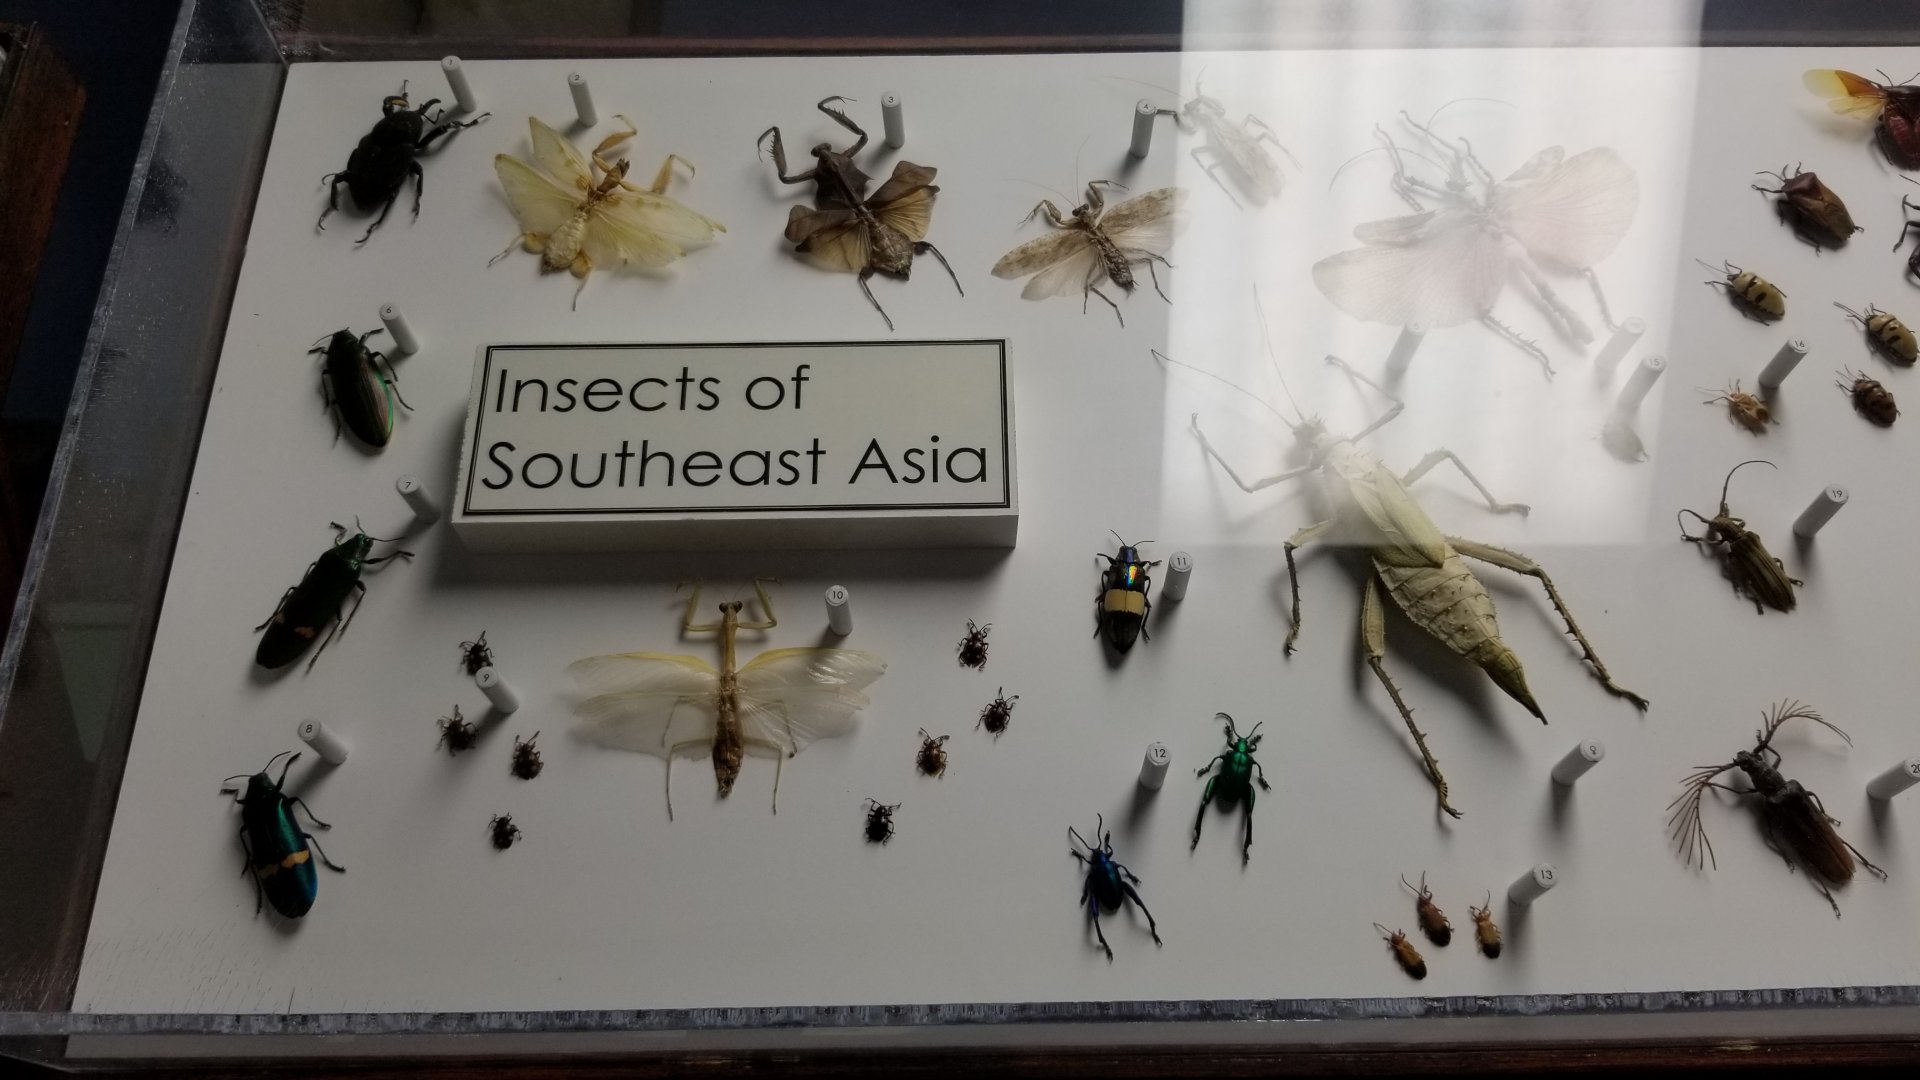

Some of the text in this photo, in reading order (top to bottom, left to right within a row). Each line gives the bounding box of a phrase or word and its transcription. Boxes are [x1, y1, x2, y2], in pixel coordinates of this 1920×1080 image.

[888, 96, 894, 104] 3
[385, 306, 392, 314] 6
[1794, 339, 1805, 348] 16
[1648, 358, 1660, 367] 15
[495, 364, 811, 413] Insects of
[481, 434, 987, 490] Southeast Asia
[404, 481, 412, 490] 7
[1832, 489, 1843, 498] 19
[1176, 557, 1187, 566] 11
[832, 590, 844, 600] 10
[483, 673, 490, 683] 9
[305, 724, 313, 734] 8
[1154, 748, 1167, 758] 12
[1540, 869, 1553, 880] 13
